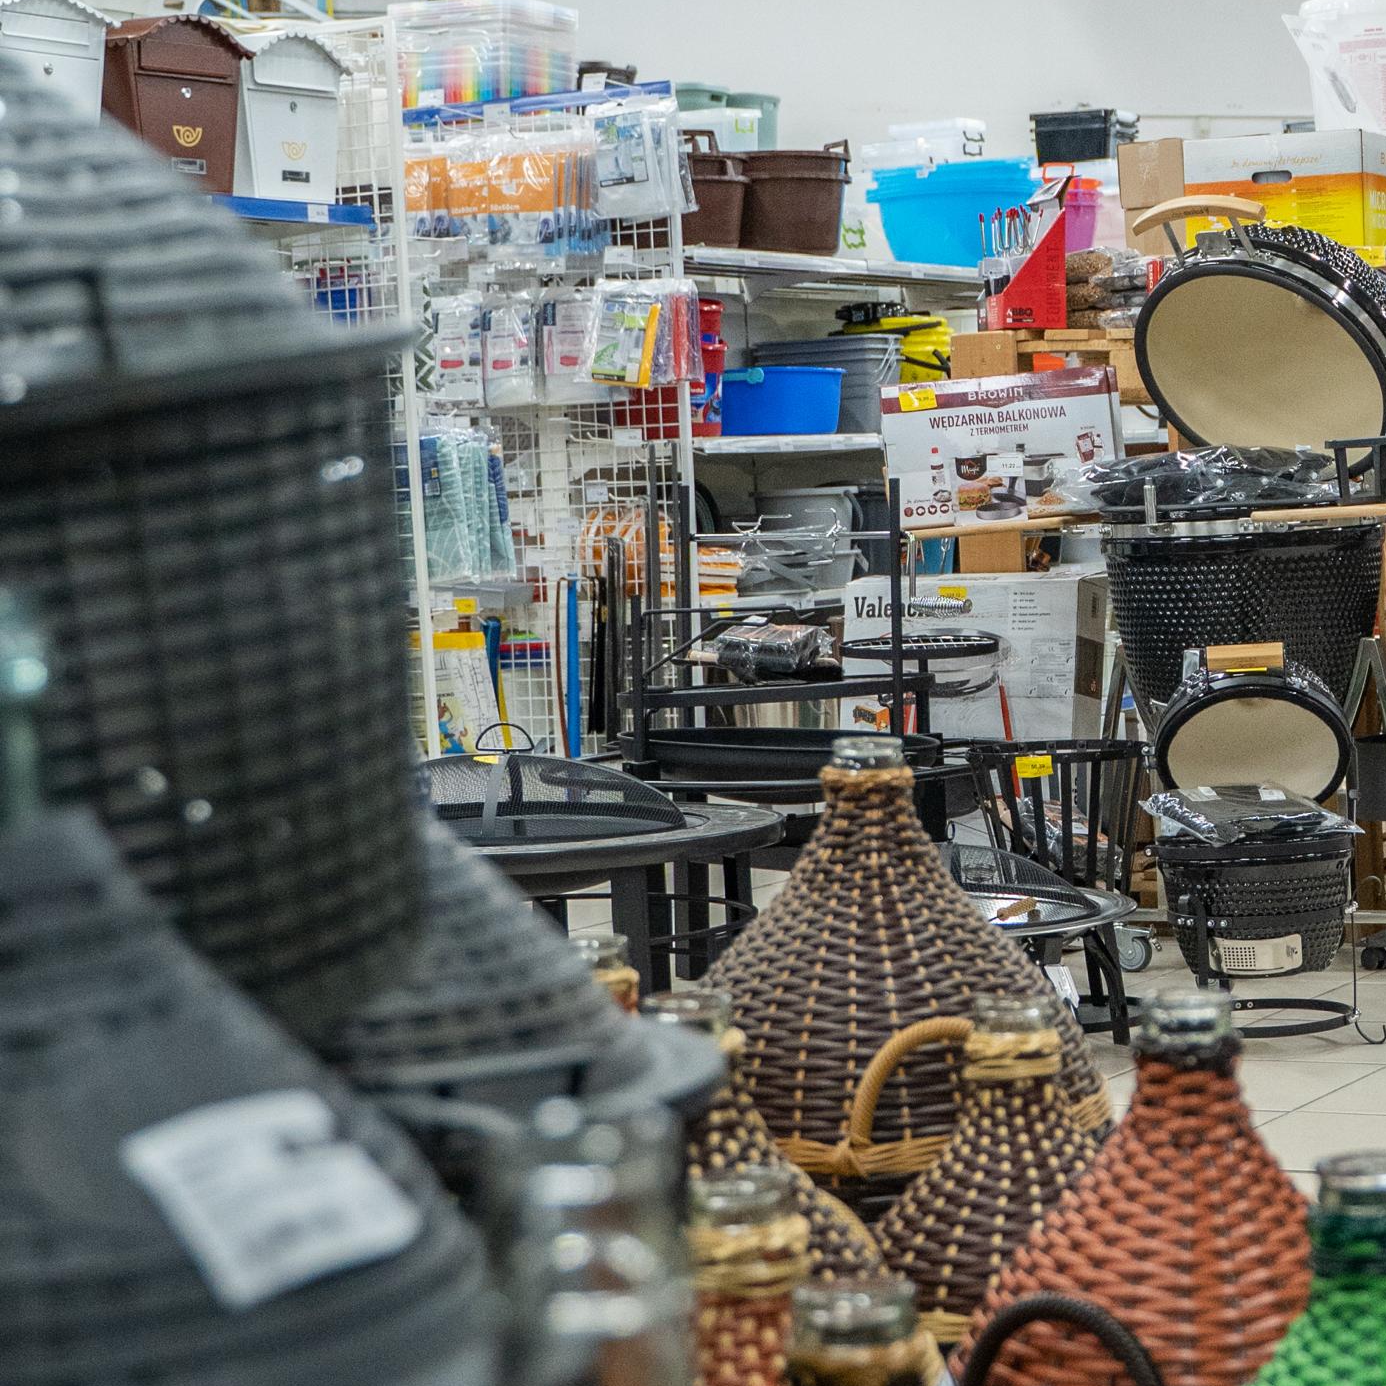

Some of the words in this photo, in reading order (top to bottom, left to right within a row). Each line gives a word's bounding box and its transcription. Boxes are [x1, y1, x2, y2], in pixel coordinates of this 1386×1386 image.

[967, 386, 1024, 401] BROWIN
[929, 410, 995, 431] WĘDZARNIA
[997, 404, 1067, 423] BALKONOWA
[970, 428, 976, 437] Z
[975, 423, 1030, 436] TERMOMETREM
